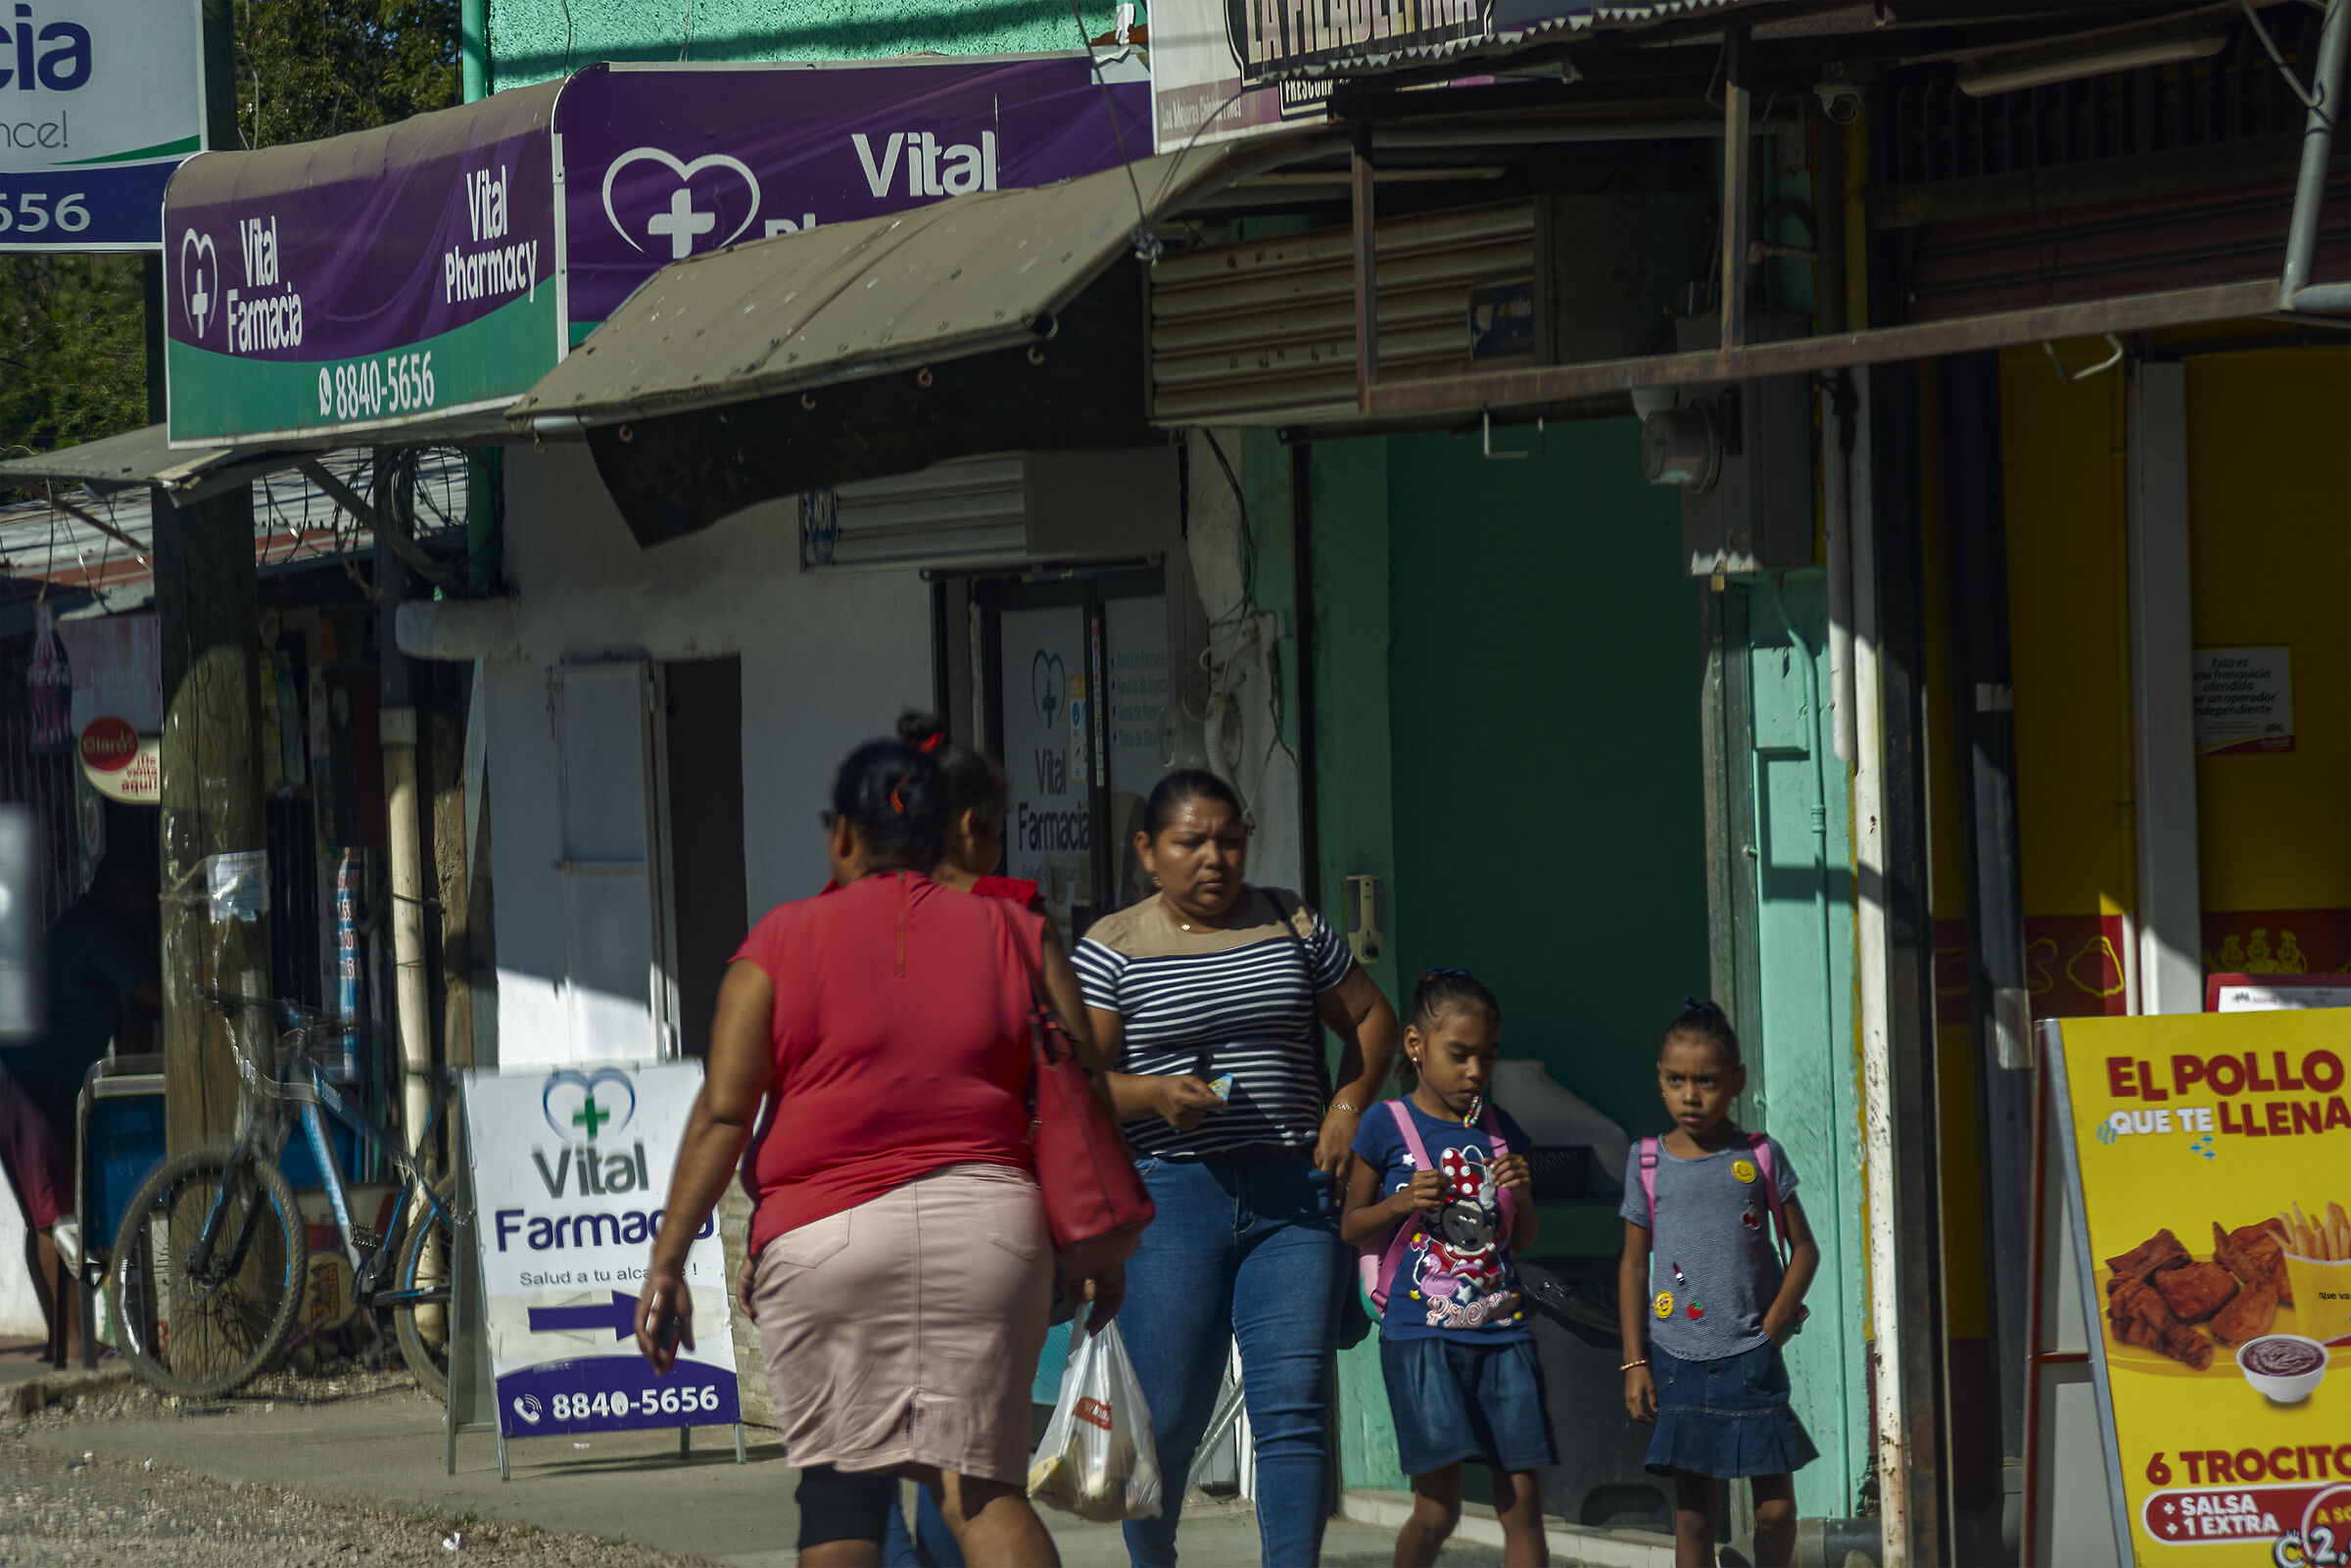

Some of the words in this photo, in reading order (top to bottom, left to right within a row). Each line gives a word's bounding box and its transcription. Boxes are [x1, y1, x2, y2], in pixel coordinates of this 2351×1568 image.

[1245, 0, 1283, 64] LA
[850, 130, 997, 197] Vital
[466, 165, 508, 242] Vital
[239, 215, 279, 287] Vital
[445, 240, 537, 304] Pharmacy
[226, 280, 303, 353] Farmacia
[335, 350, 435, 421] 8840-5656
[2211, 658, 2234, 668] Esta
[2236, 659, 2249, 668] es
[2214, 667, 2272, 681] franquicia
[2194, 704, 2273, 718] ndependiente
[2225, 691, 2277, 705] operador
[1034, 748, 1067, 796] Vital
[1018, 800, 1090, 851] Farmacia
[2106, 1056, 2169, 1102] EL
[2171, 1049, 2346, 1097] POLLO
[2108, 1109, 2173, 1135] QUE
[2175, 1107, 2215, 1133] TE
[2217, 1096, 2351, 1137] LLENA
[532, 1142, 649, 1200] Vital
[495, 1208, 717, 1254] Farmac
[520, 1271, 571, 1286] Salud
[577, 1274, 589, 1283] a
[594, 1269, 611, 1282] tu
[552, 1385, 720, 1420] 8840-5656
[2146, 1452, 2172, 1486] 6
[2180, 1494, 2259, 1517] SALSA
[2183, 1518, 2196, 1536] 1
[2201, 1512, 2280, 1536] EXTRA
[2317, 1508, 2331, 1525] A
